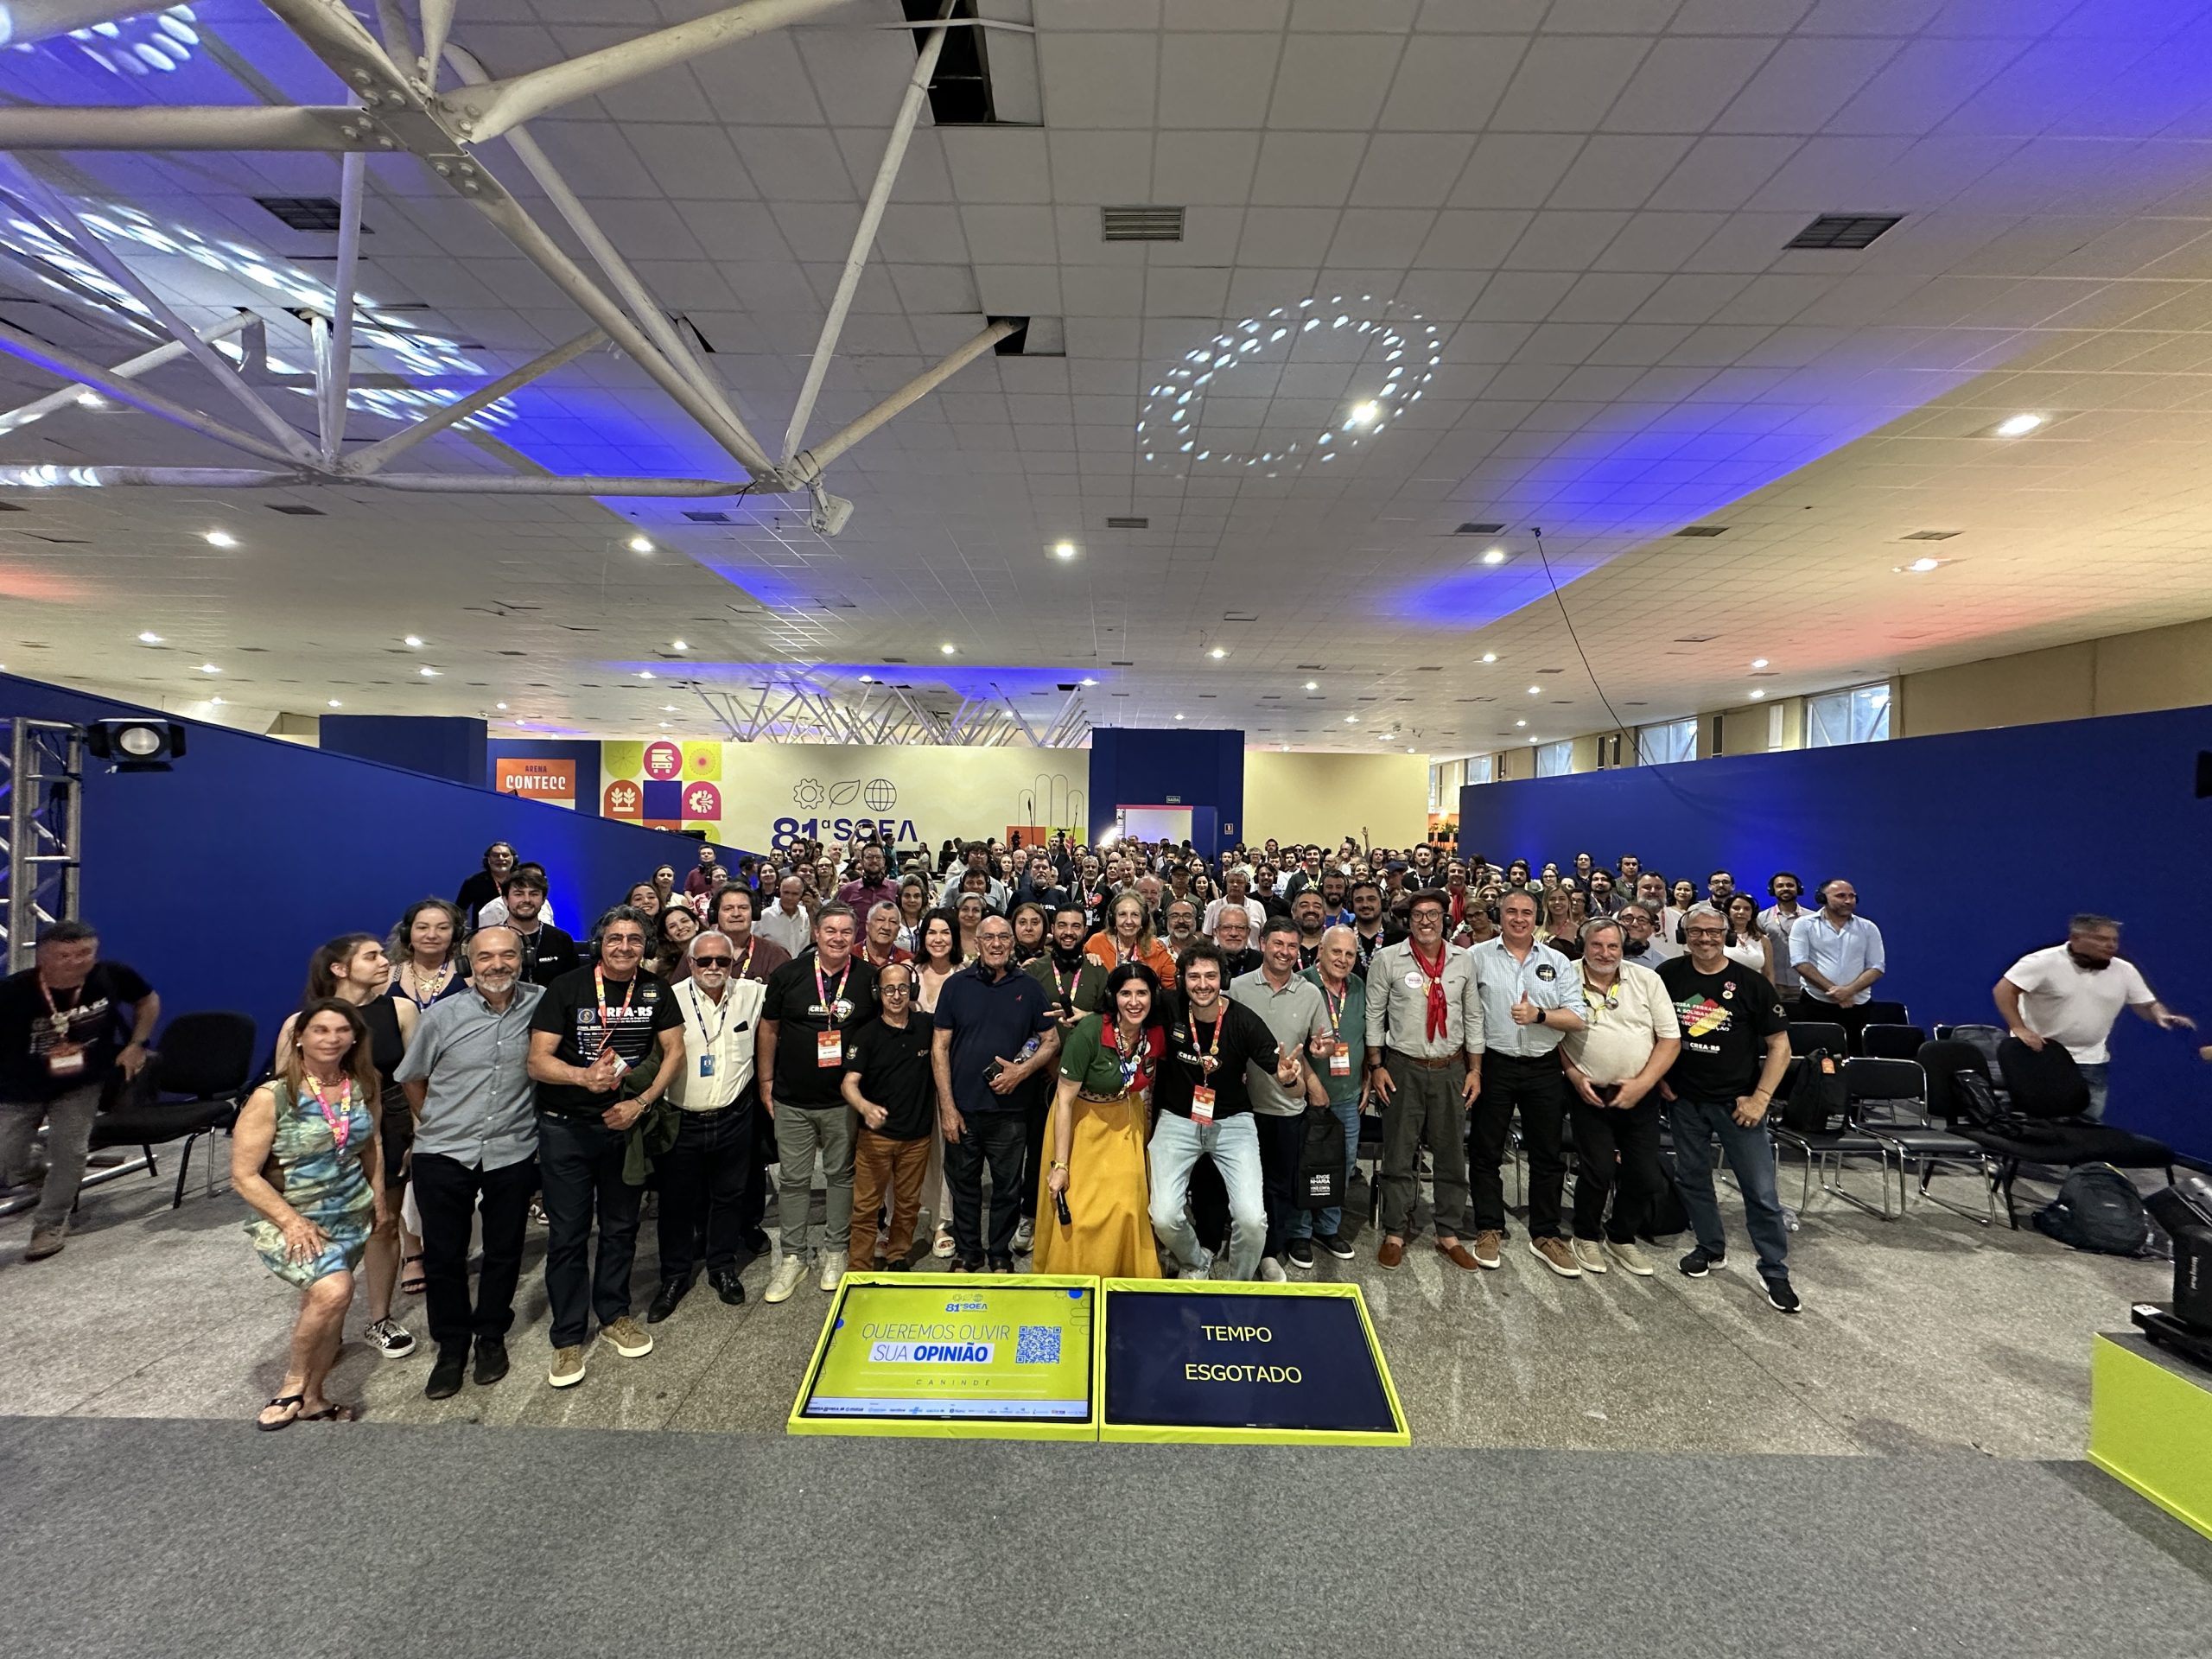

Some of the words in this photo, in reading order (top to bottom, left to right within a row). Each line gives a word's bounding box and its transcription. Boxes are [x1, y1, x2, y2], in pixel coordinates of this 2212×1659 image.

[505, 774, 566, 790] CONTECC
[1689, 1042, 1720, 1052] CREA-RS
[1179, 1052, 1198, 1062] CREA
[861, 1323, 956, 1340] QUEREMOS
[959, 1325, 1010, 1340] OUVIR
[1200, 1325, 1272, 1343] TEMPO
[874, 1344, 907, 1361] SUA
[913, 1341, 988, 1363] OPINIÃO
[1185, 1363, 1302, 1383] ESGOTADO
[916, 1377, 990, 1386] CANINDÉ
